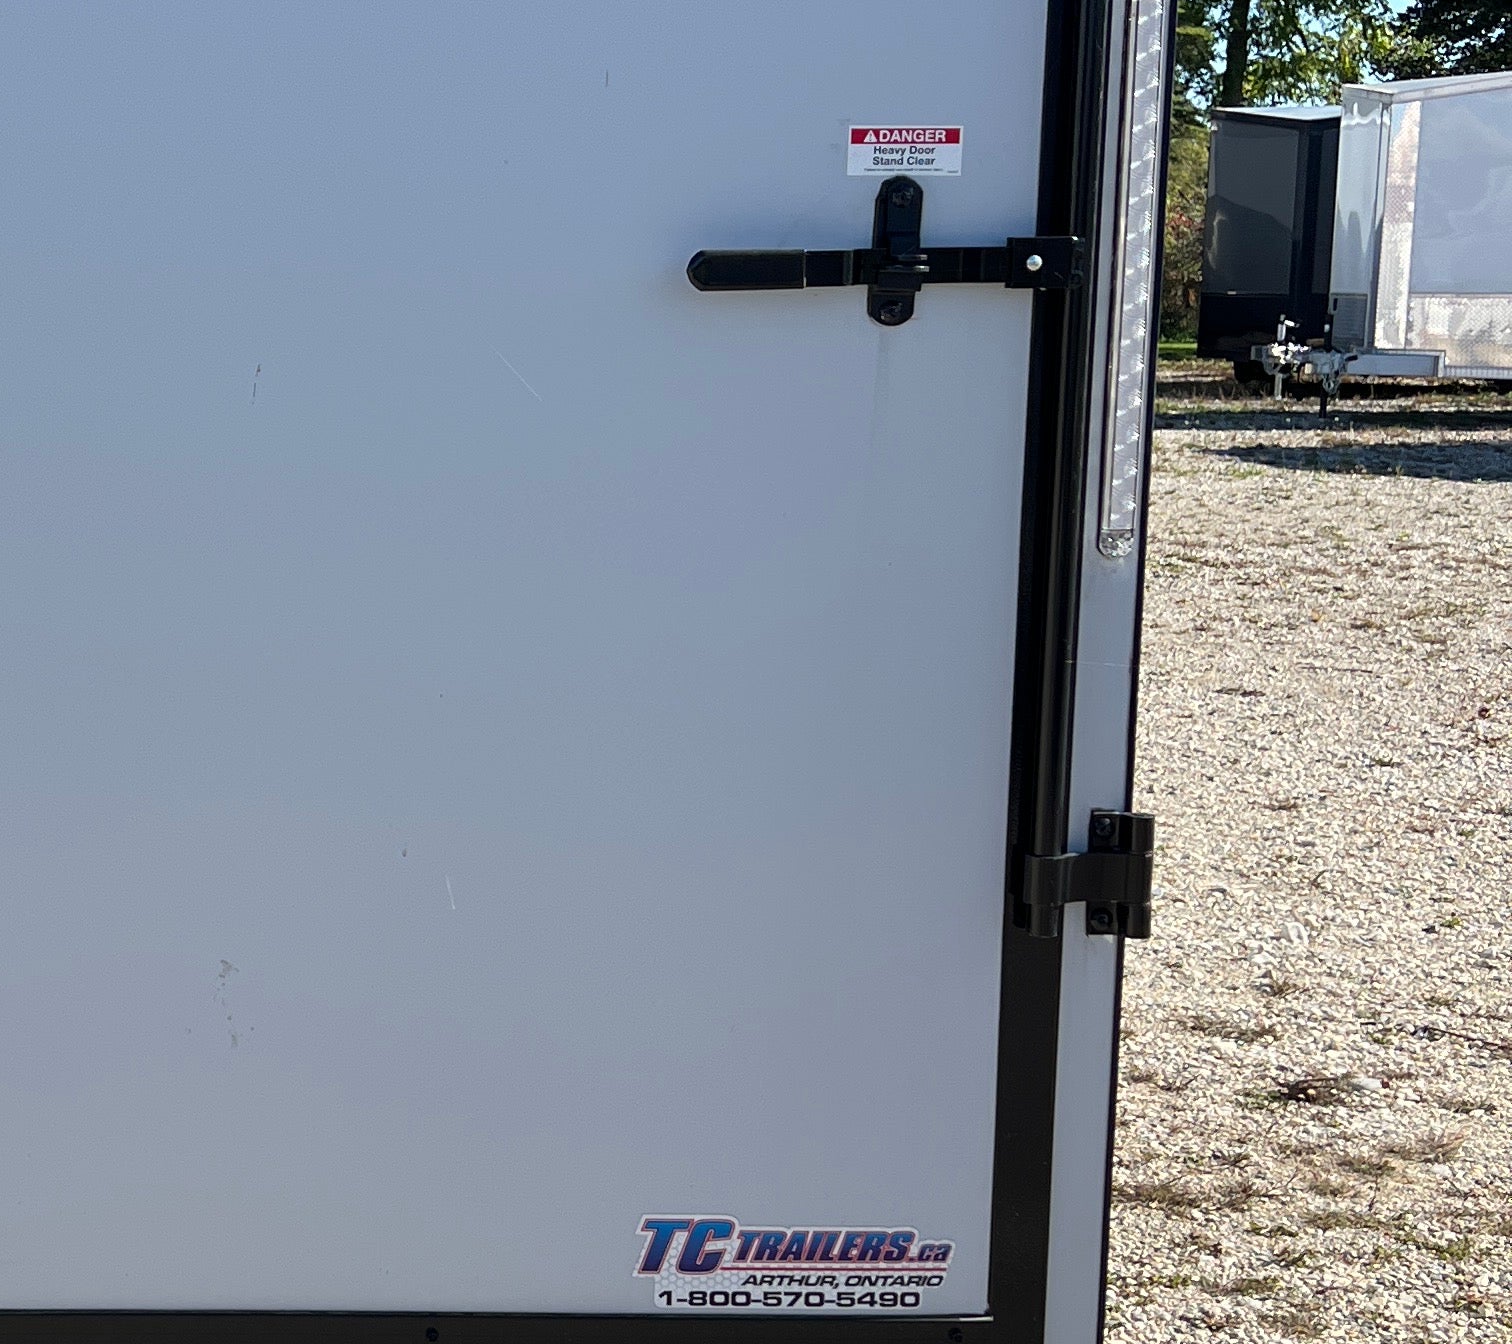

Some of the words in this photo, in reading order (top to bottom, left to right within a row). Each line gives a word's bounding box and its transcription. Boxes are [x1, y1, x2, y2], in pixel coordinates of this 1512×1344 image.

[879, 130, 947, 143] DANGER
[873, 145, 907, 156] Heavy
[909, 145, 936, 155] Door
[872, 156, 904, 166] Stand
[907, 156, 936, 166] Clear
[638, 1218, 736, 1275] TC
[736, 1229, 953, 1265] TRAILERS.ca
[741, 1274, 839, 1290] ARTHUR,
[844, 1274, 944, 1288] ONTARIO
[658, 1291, 921, 1308] 1-800-570-5490
